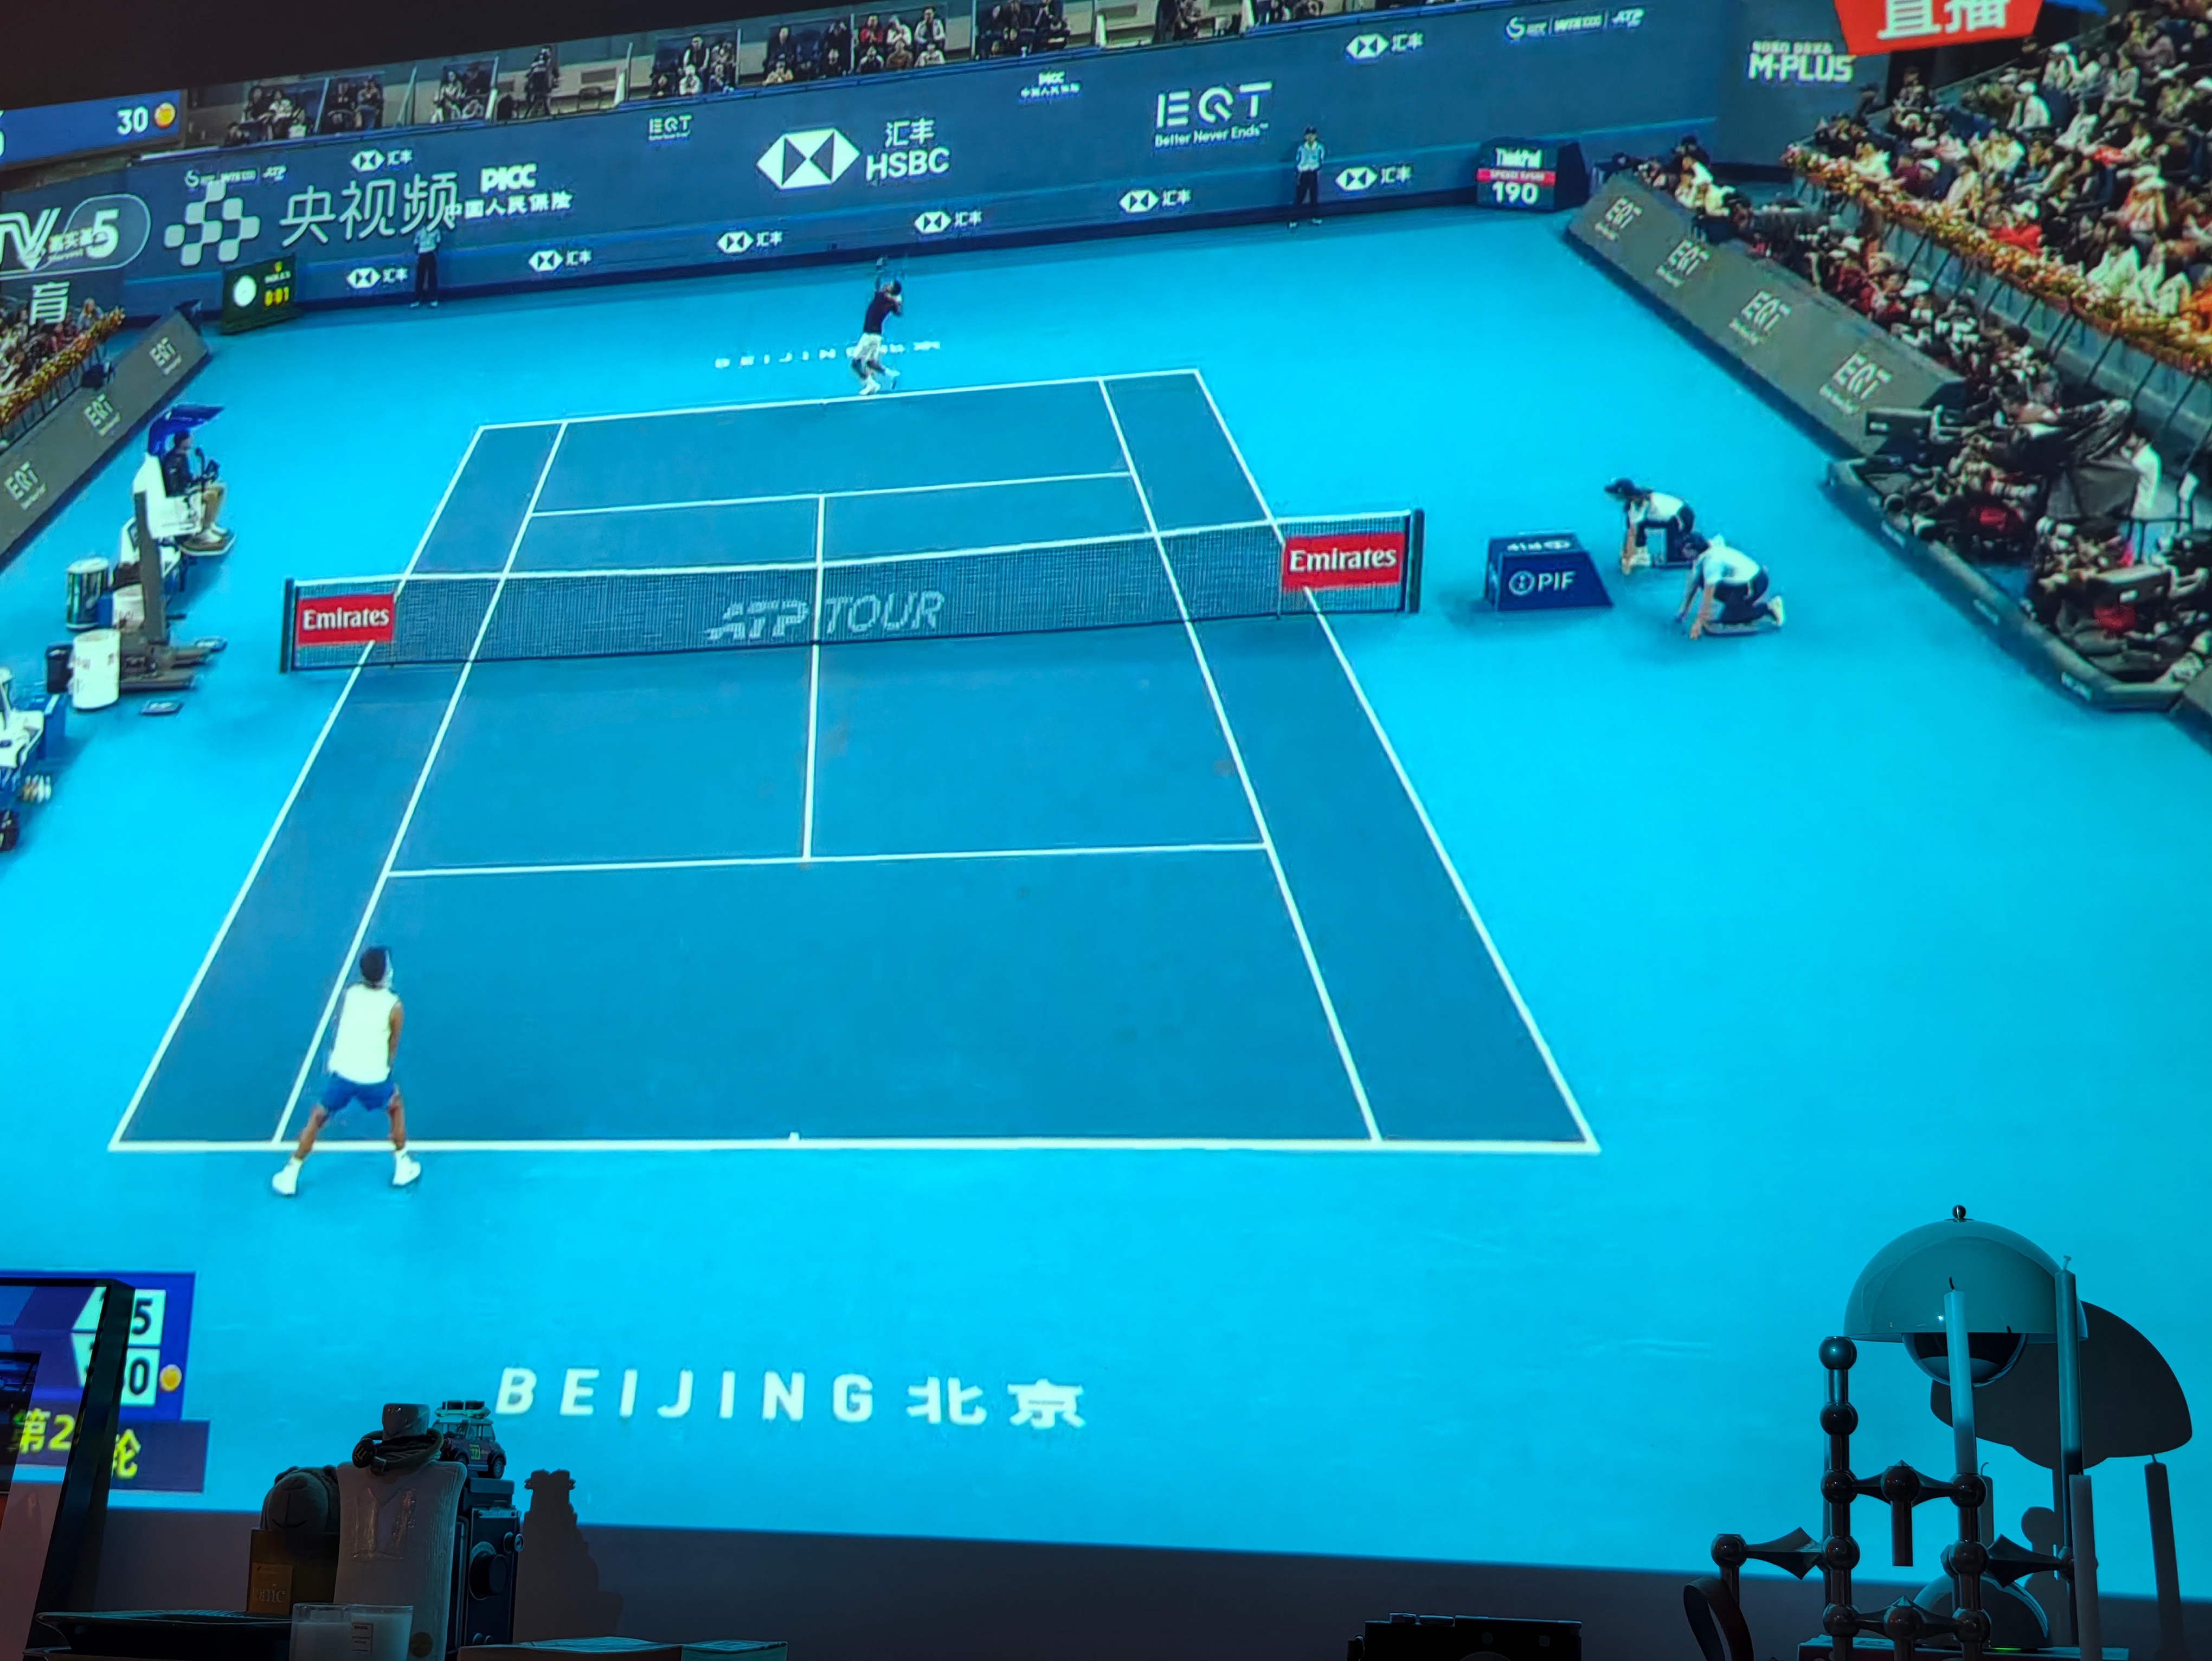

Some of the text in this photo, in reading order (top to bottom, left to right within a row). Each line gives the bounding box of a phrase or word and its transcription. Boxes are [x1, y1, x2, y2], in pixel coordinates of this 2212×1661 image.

[1877, 0, 2008, 40] 直播
[117, 106, 149, 135] 30
[1156, 80, 1273, 128] EQT
[649, 114, 693, 134] EQT
[884, 117, 935, 147] 汇丰
[866, 146, 951, 182] HSBC
[1492, 181, 1540, 205] 190
[279, 172, 459, 248] 央视频
[29, 281, 70, 326] 育
[1289, 546, 1397, 572] Emirates
[1538, 571, 1577, 592] PIF
[303, 607, 390, 631] Emirates
[705, 589, 945, 641] ATP TOUR
[495, 1366, 1086, 1430] BEIJING 北京
